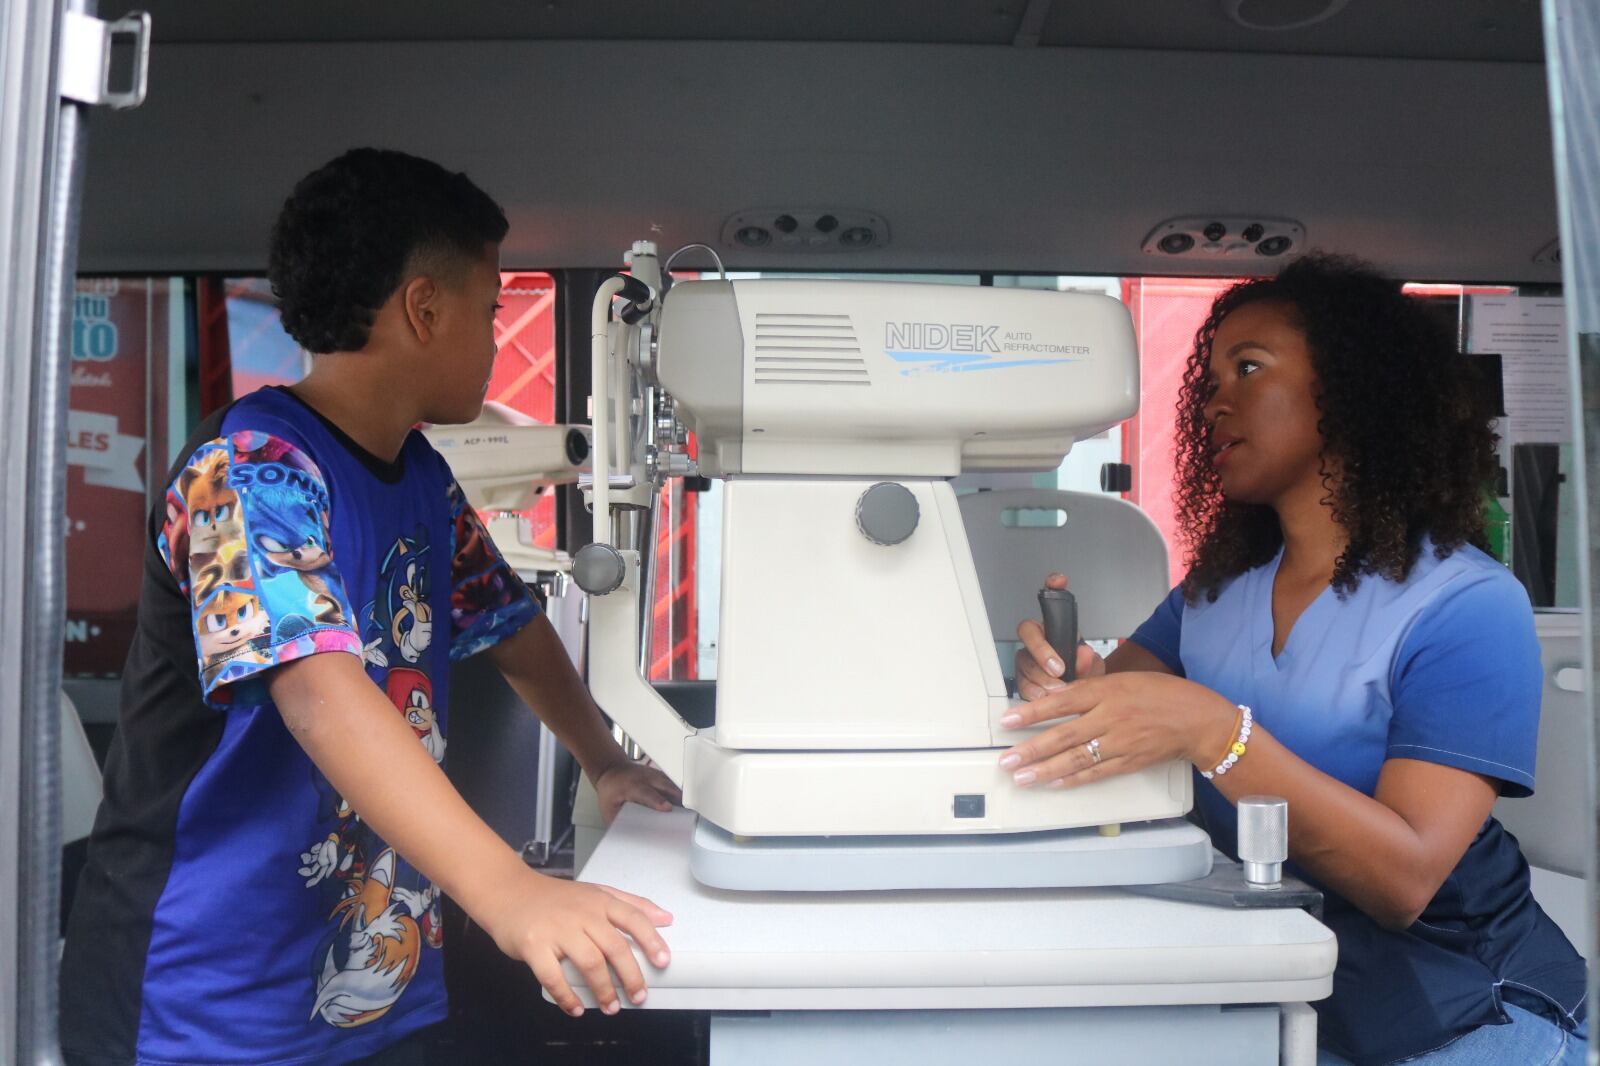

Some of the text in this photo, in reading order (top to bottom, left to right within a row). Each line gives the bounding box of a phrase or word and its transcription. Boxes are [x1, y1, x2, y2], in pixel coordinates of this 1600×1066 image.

[884, 321, 1032, 353] NIDEK AUTO
[1003, 342, 1091, 355] REFRACTOMETER
